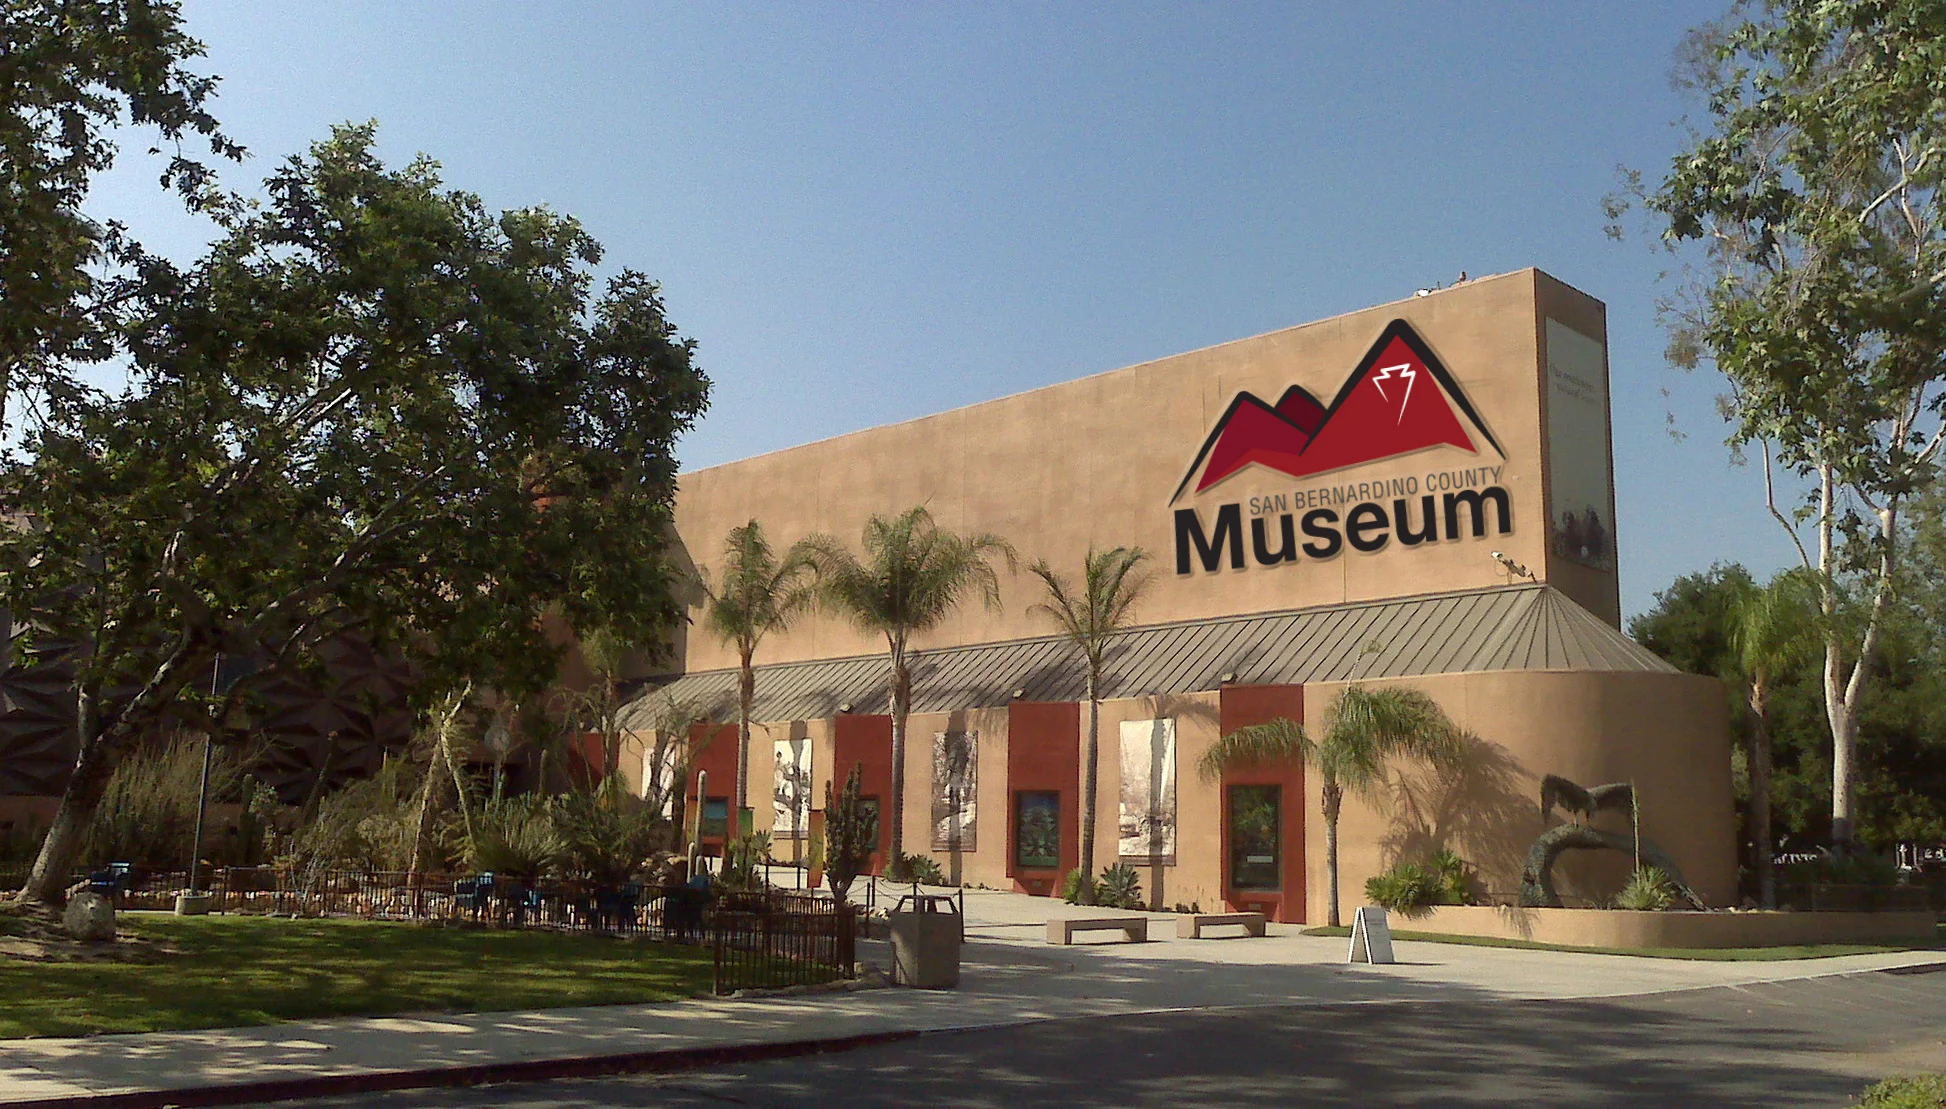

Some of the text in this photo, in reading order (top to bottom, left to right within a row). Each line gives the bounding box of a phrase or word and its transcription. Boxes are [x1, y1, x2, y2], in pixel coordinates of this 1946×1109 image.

[1250, 466, 1502, 516] SAN BERNARDINO COUNTY
[1174, 485, 1512, 576] Museum
